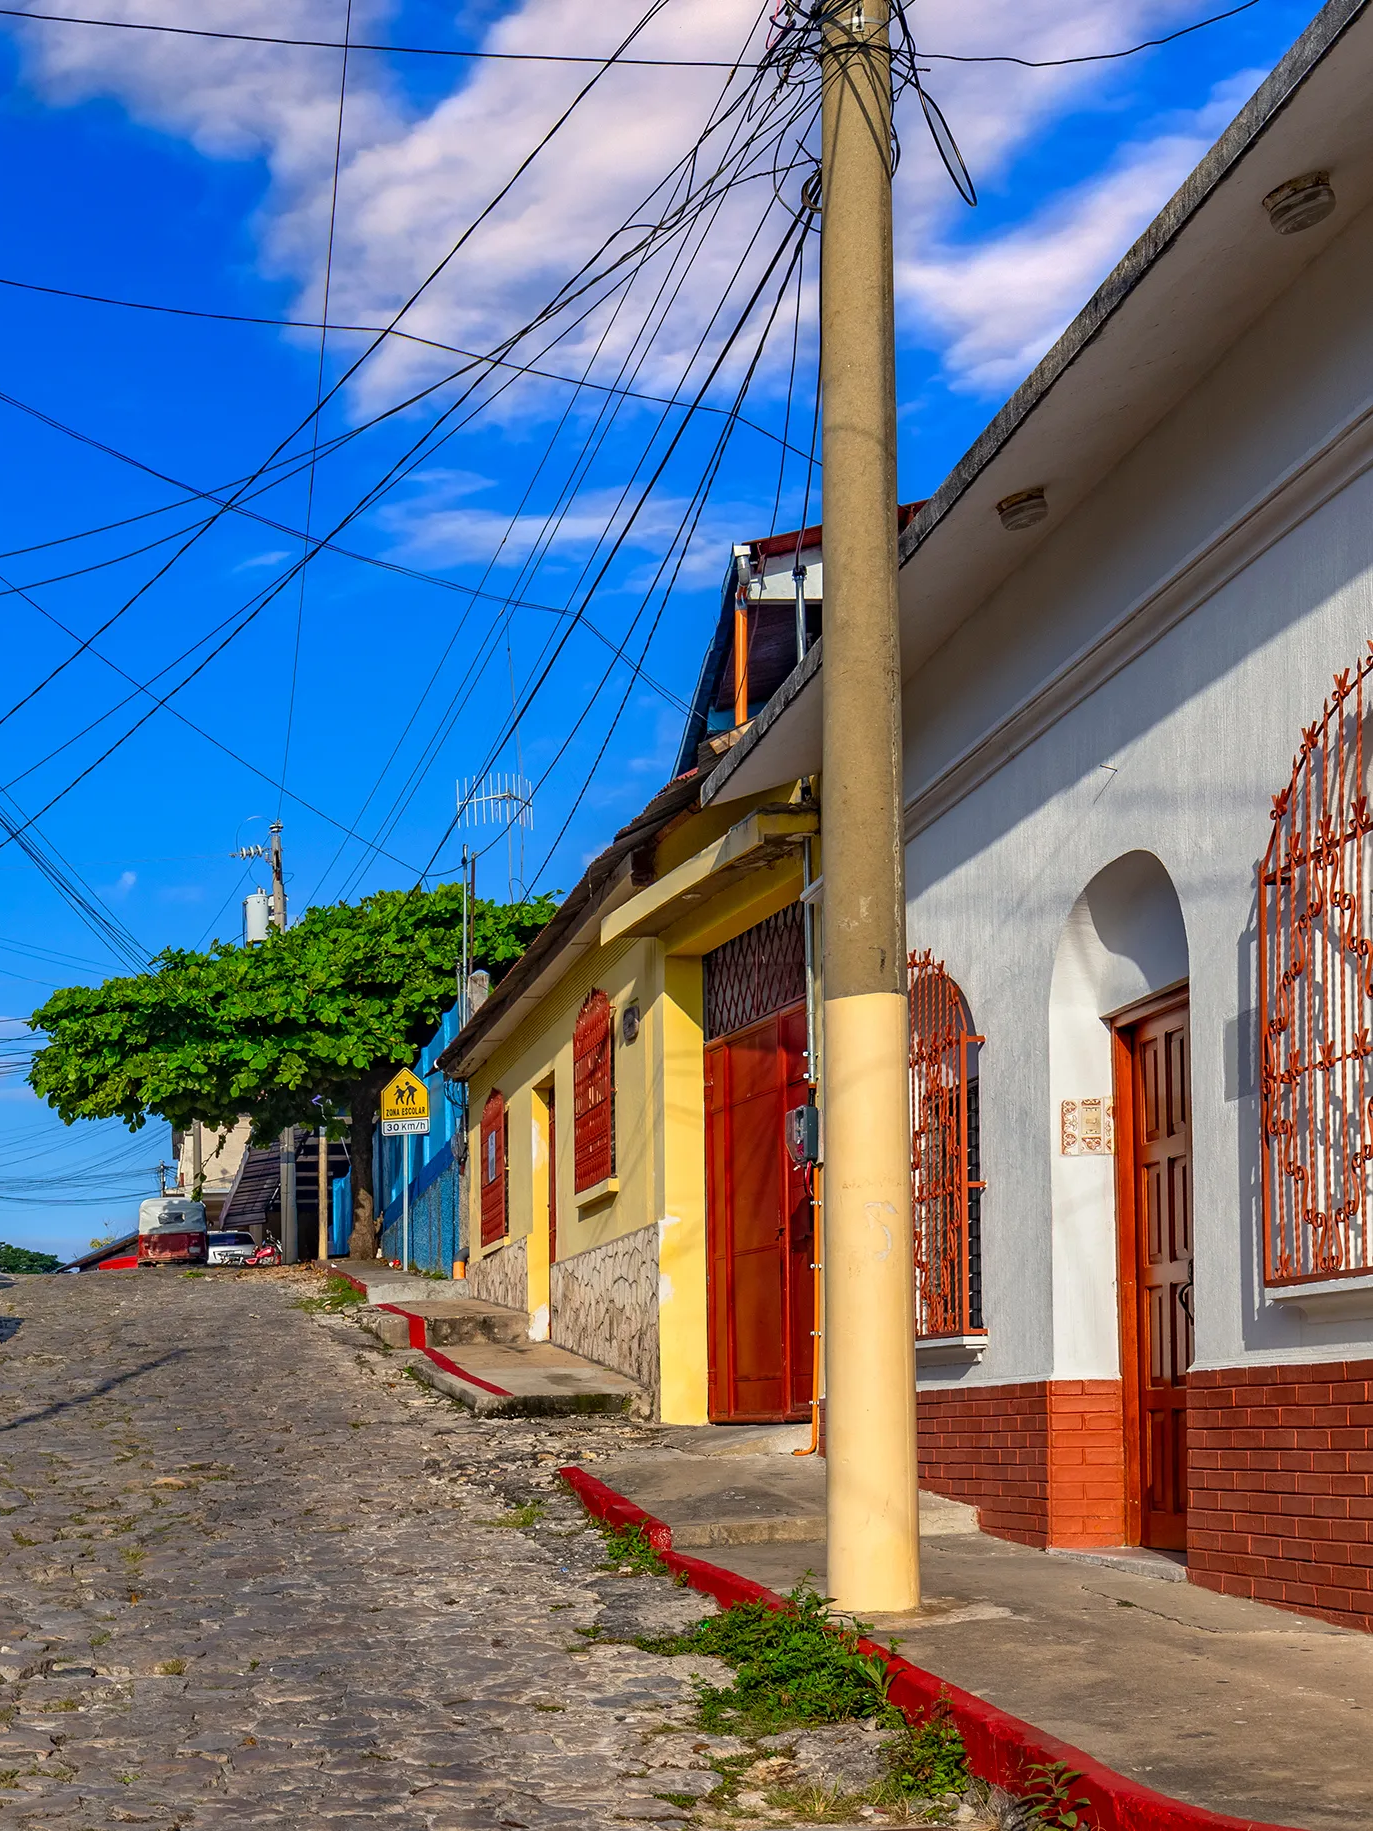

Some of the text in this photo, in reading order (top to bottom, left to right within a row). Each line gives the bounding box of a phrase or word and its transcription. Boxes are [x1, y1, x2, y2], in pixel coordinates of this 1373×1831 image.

[386, 1106, 426, 1117] ZONA ESCOLAR
[386, 1121, 426, 1132] 30 Km/h
